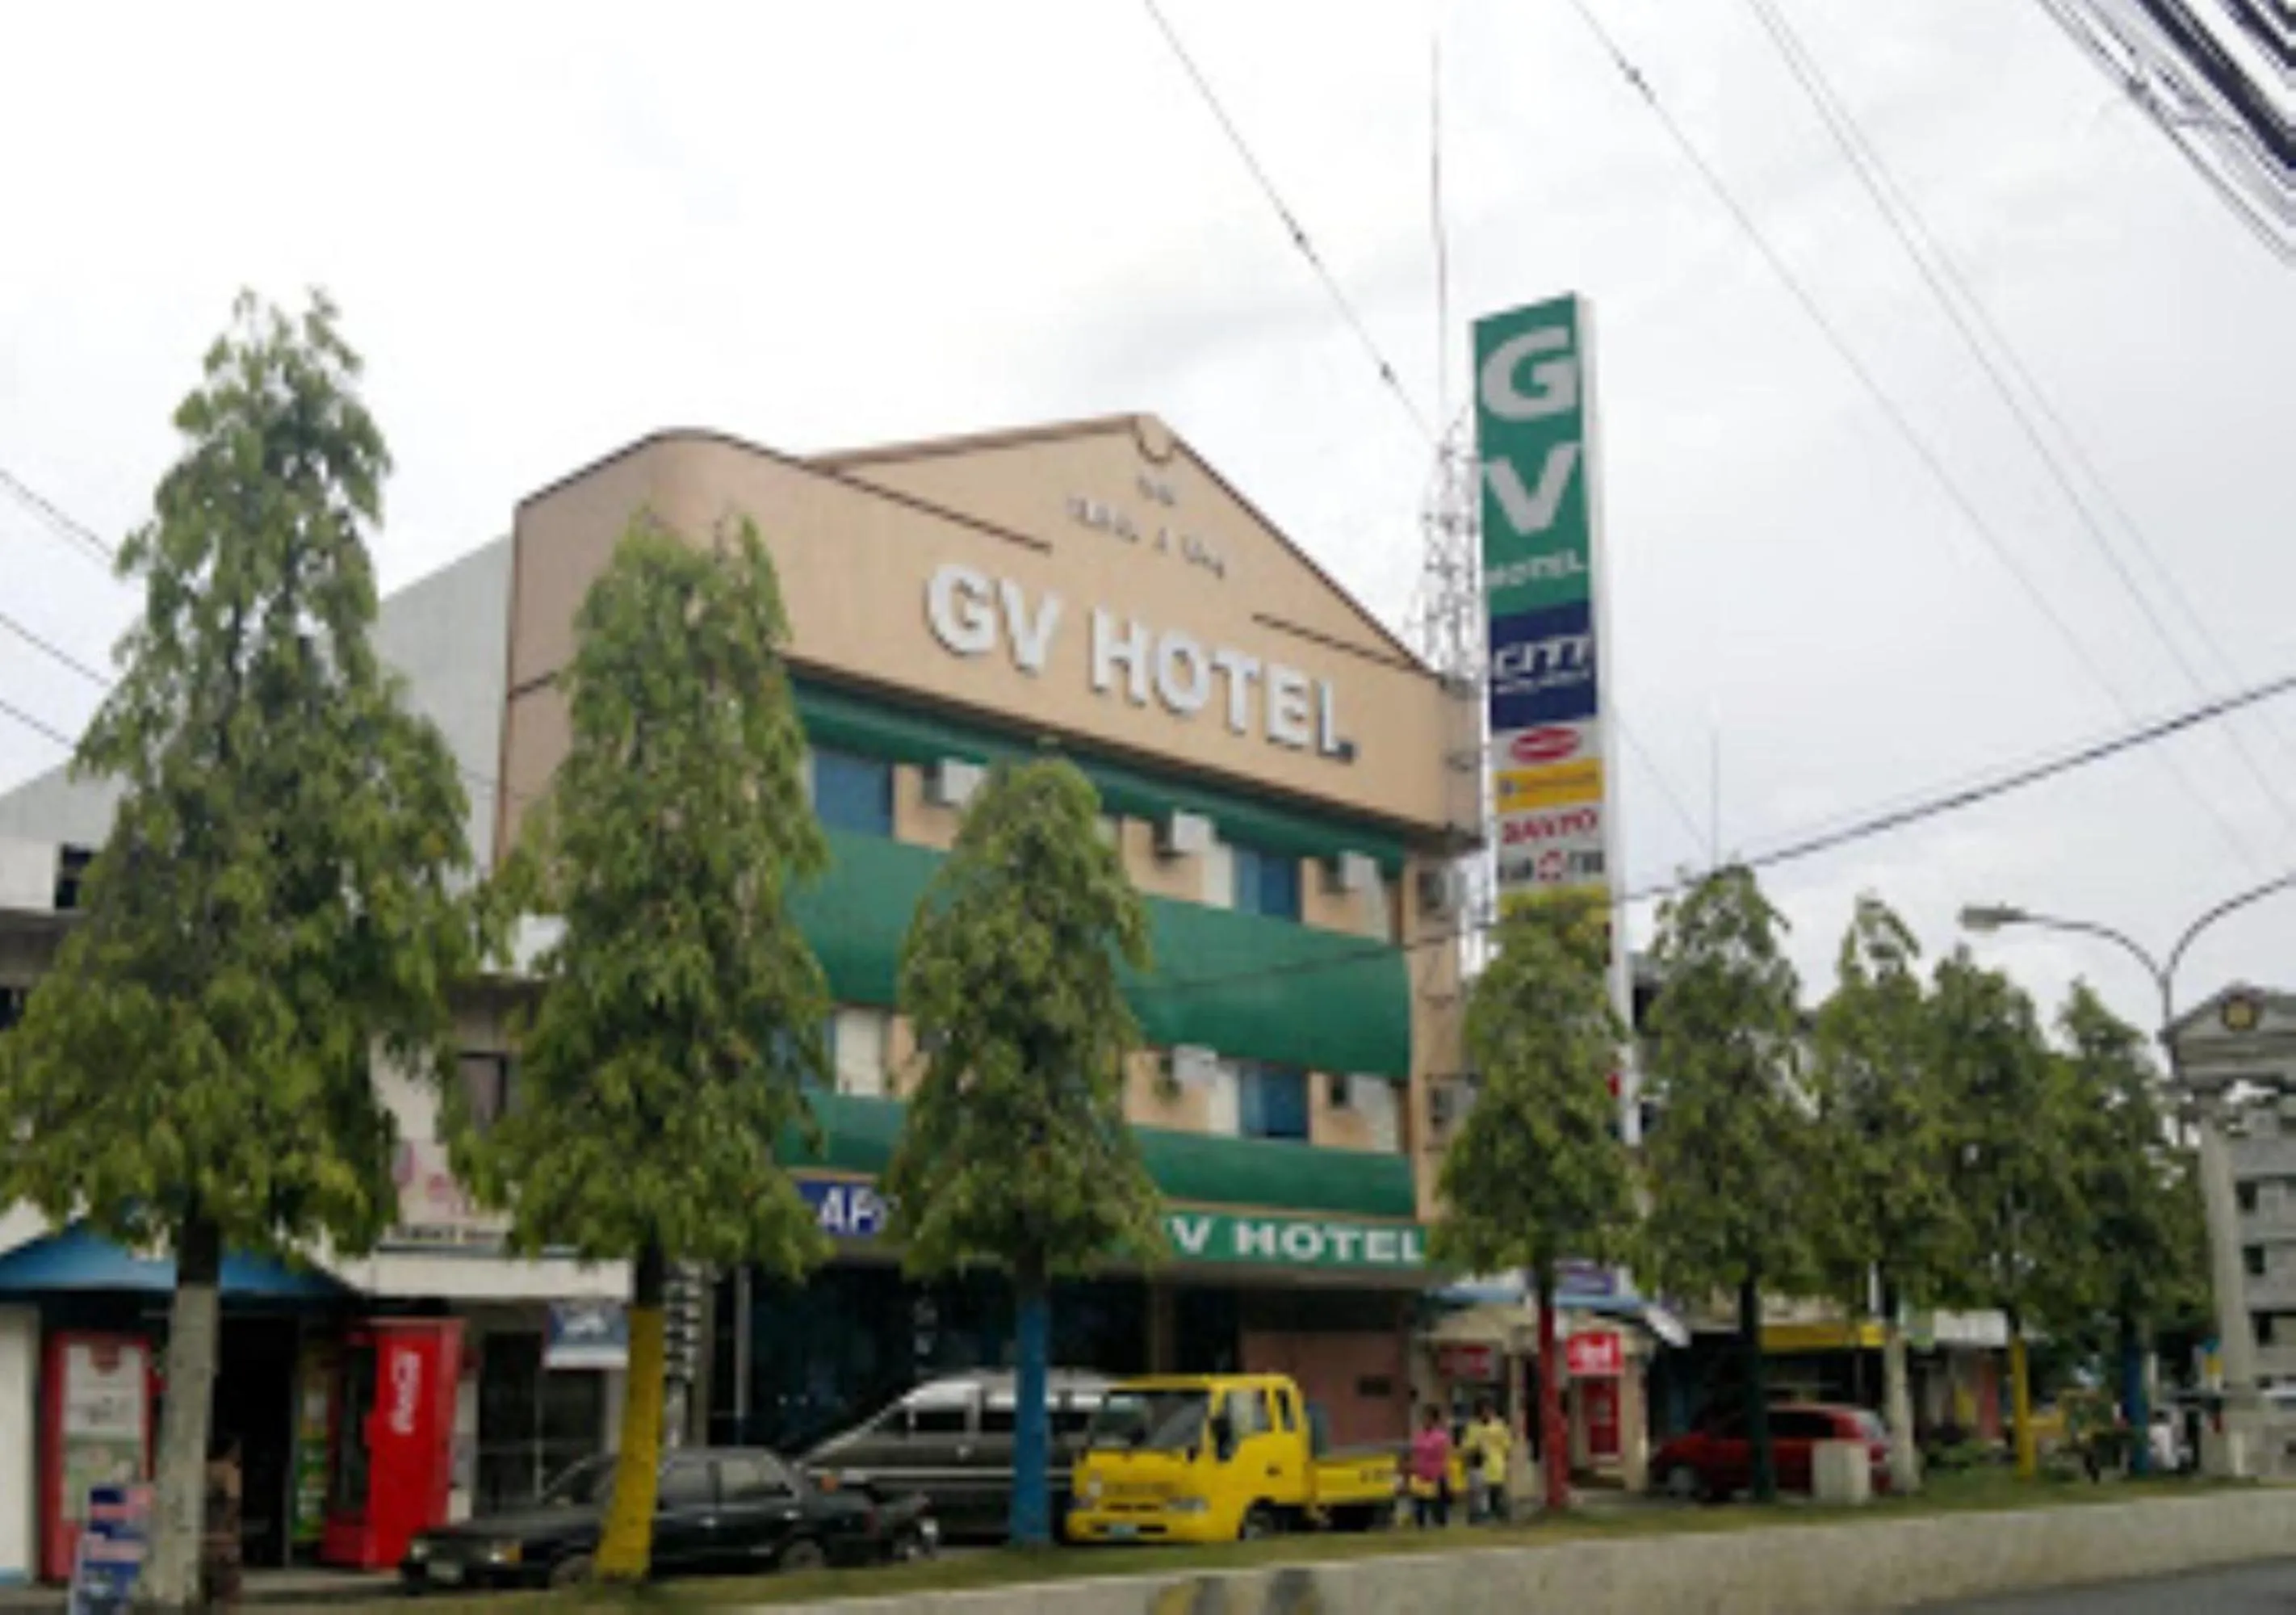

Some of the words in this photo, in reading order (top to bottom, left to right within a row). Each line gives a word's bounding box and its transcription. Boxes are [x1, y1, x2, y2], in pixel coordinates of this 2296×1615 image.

[926, 564, 1059, 674] GV
[1091, 604, 1357, 762] HOTEL
[1235, 1219, 1427, 1263] HOTEL
